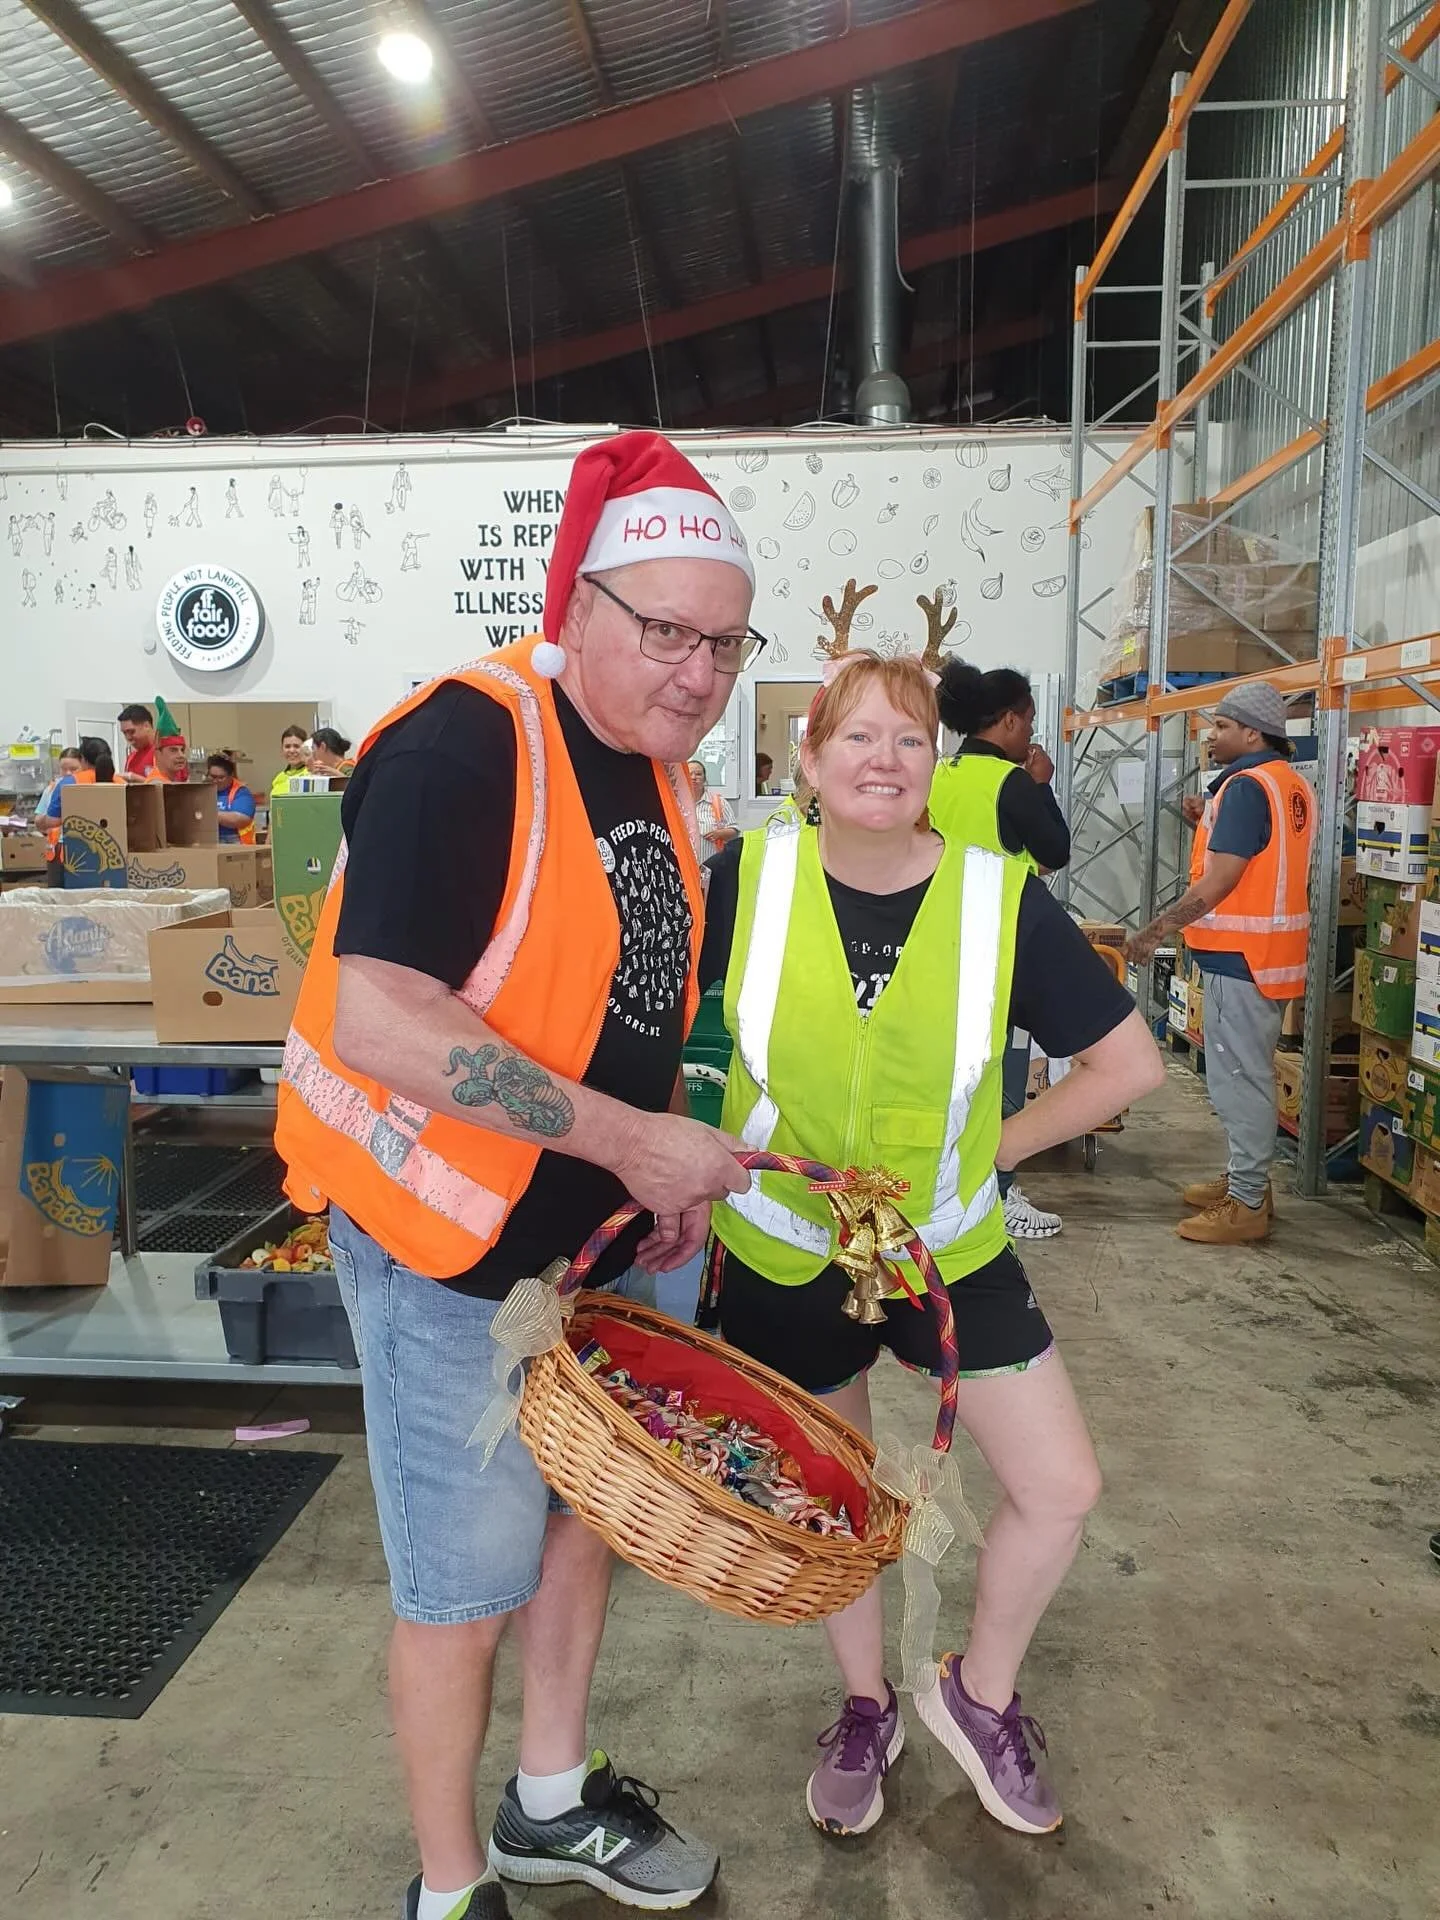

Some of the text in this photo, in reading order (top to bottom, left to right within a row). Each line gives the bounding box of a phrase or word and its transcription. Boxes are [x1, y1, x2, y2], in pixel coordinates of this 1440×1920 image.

[478, 524, 502, 547] IS
[623, 515, 667, 543] HO
[680, 515, 721, 541] HO
[184, 569, 202, 583] NOT
[460, 558, 525, 581] WITH
[207, 568, 250, 606] LANDFILL
[161, 581, 184, 617] PEOPLE
[454, 592, 544, 615] ILLNESS
[192, 602, 223, 622] fair
[186, 617, 230, 638] food
[162, 621, 193, 660] FEEDING
